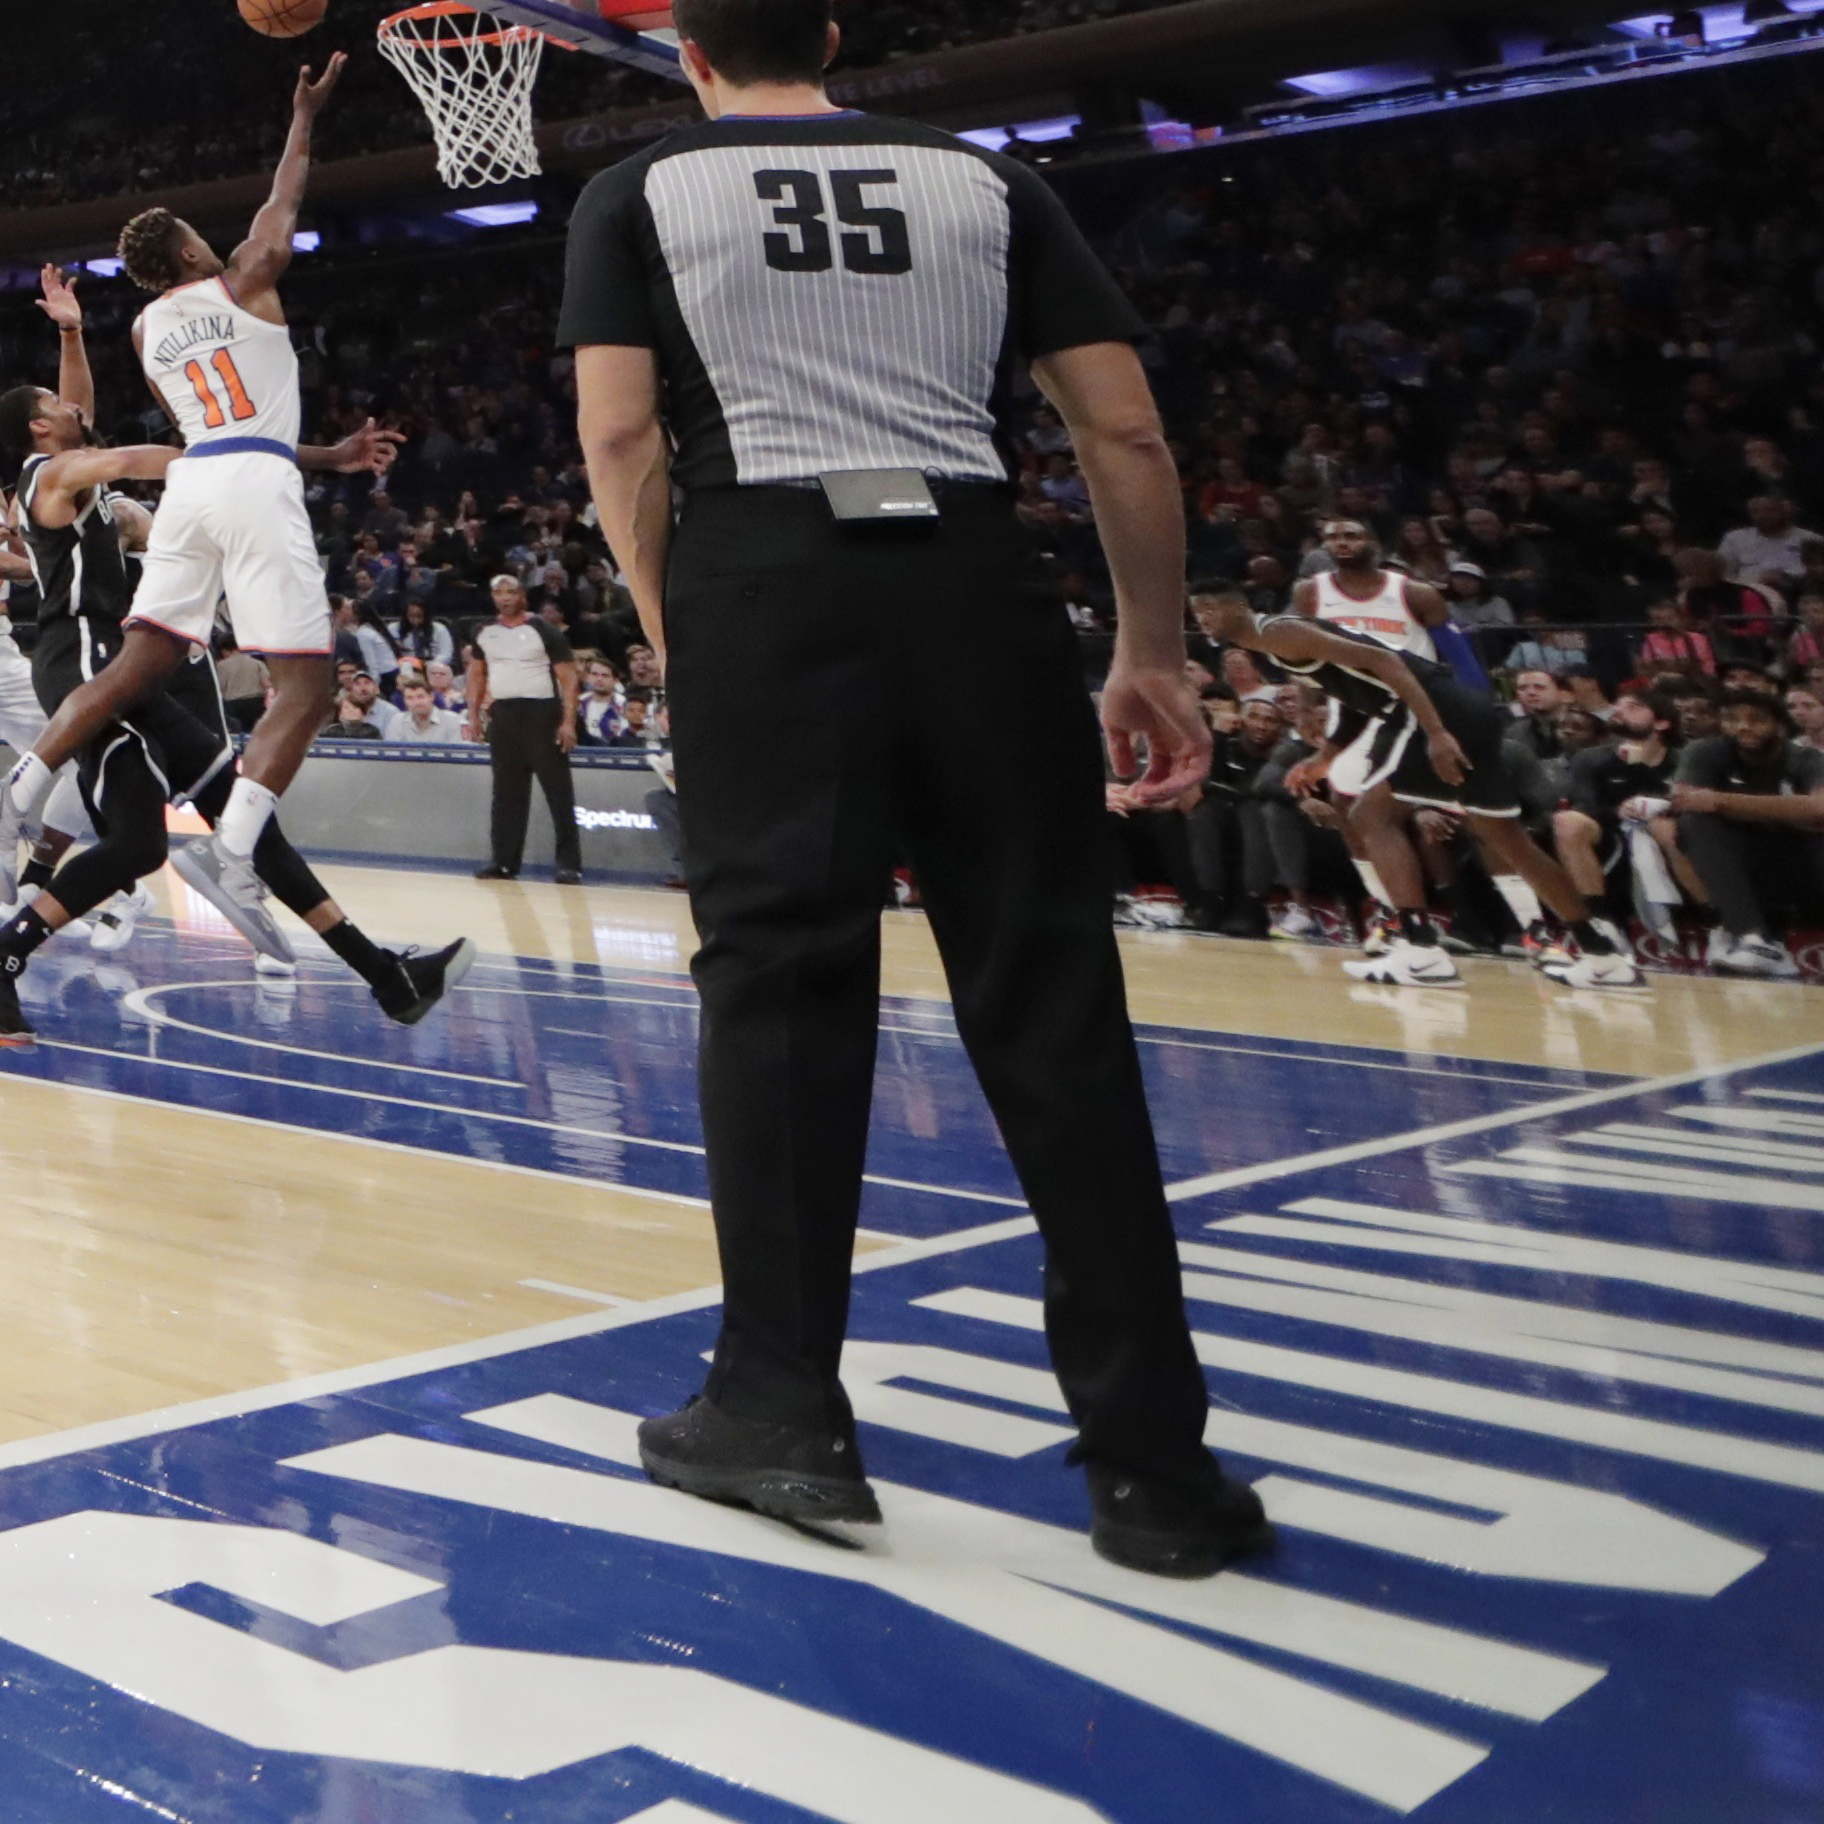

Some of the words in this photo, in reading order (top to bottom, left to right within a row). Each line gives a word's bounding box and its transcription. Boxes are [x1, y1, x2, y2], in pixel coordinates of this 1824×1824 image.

[751, 168, 913, 276] 35
[152, 314, 238, 372] NTILIKINA
[183, 347, 258, 429] 11
